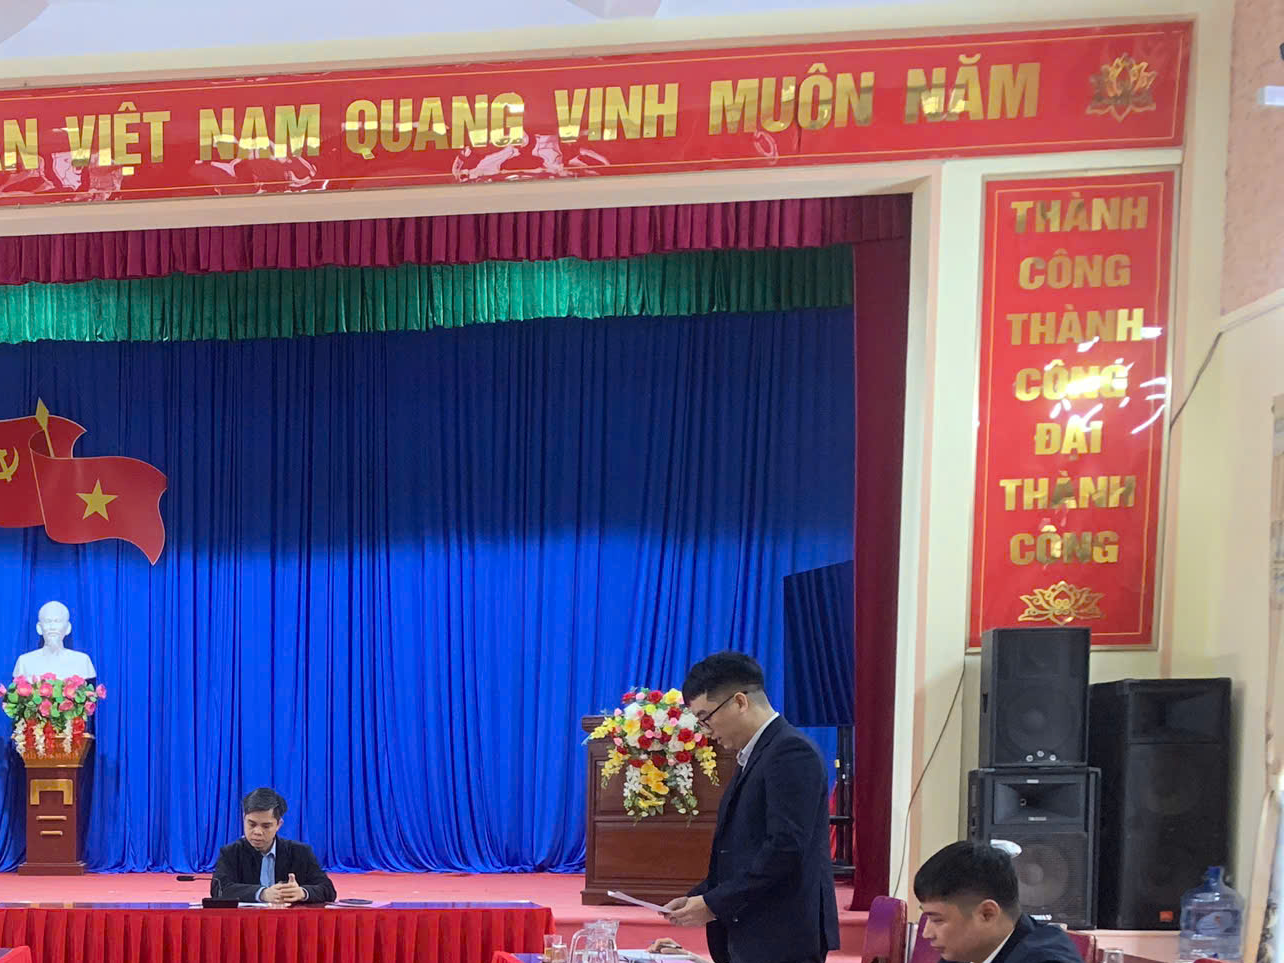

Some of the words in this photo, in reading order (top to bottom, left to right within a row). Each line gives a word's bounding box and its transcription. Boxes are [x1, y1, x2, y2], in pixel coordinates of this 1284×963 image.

[65, 102, 171, 176] VIỆT
[199, 103, 322, 161] NAM
[344, 92, 526, 160] QUANG
[554, 82, 679, 143] VINH
[708, 63, 875, 135] MUÔN
[904, 53, 1041, 124] NĂM
[1010, 191, 1149, 234] THÀNH
[1018, 248, 1132, 290] CÔNG
[1006, 303, 1145, 346] THÀNH
[1014, 358, 1129, 402] CÔNG
[1034, 420, 1104, 461] ĐẠI
[999, 470, 1137, 511] THÀNH
[1010, 524, 1119, 565] CÔNG
